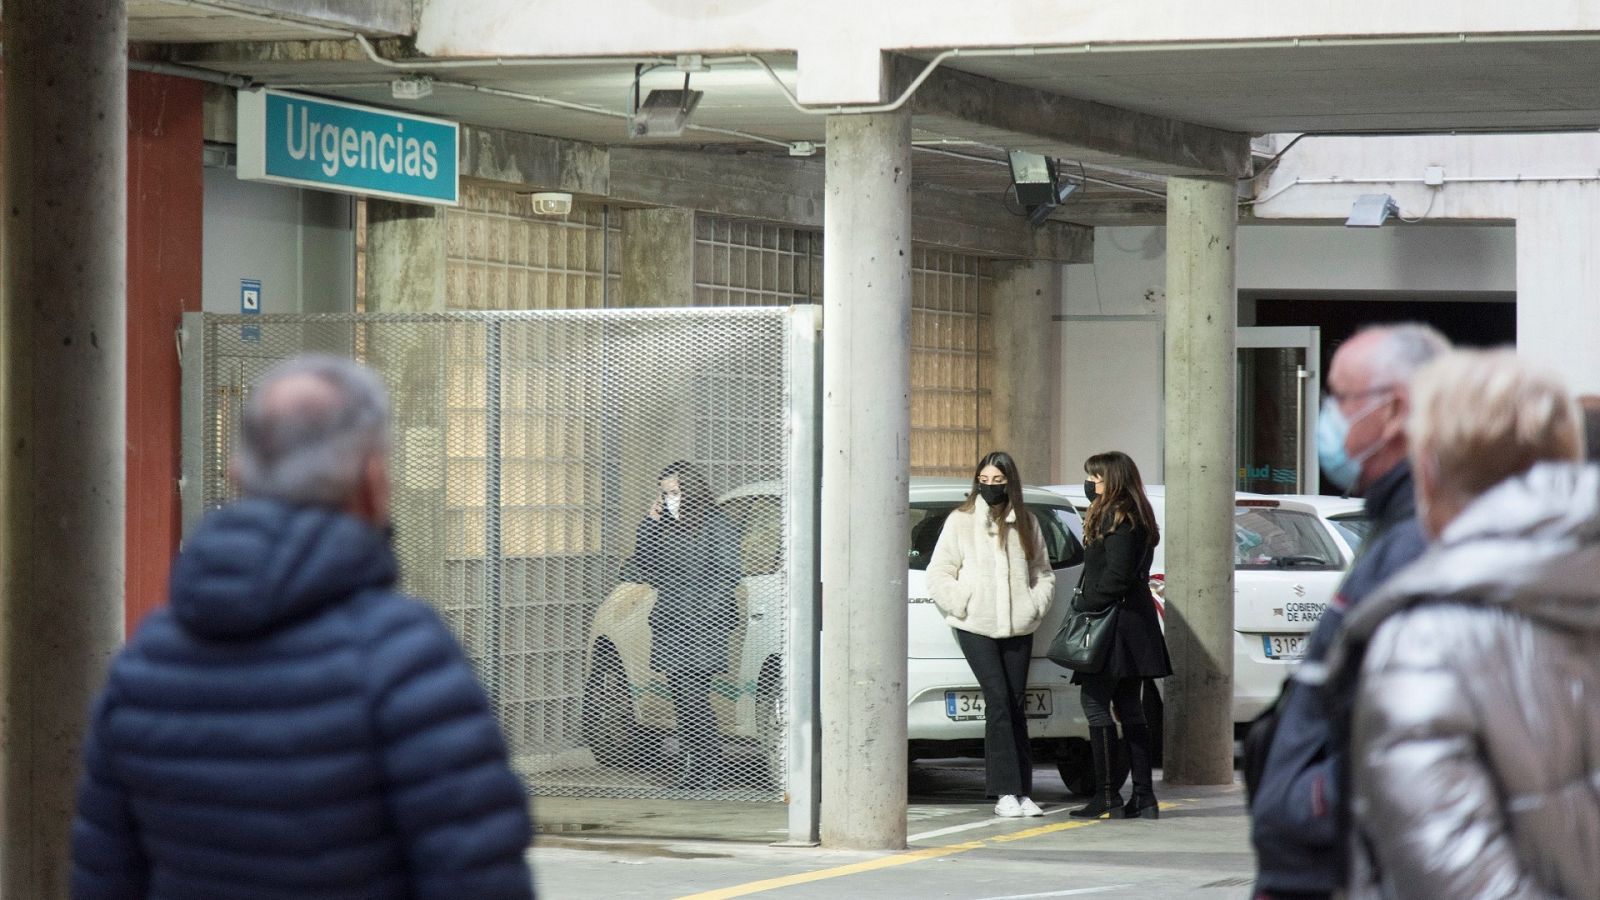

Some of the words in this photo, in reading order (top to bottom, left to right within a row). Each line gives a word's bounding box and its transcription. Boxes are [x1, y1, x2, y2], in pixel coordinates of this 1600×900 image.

[286, 103, 438, 180] Urgencias
[1238, 464, 1270, 478] alud
[1286, 602, 1327, 612] GOBIERNO
[1287, 612, 1299, 622] DE
[1302, 612, 1322, 622] ARA
[960, 694, 982, 712] 34
[1024, 693, 1046, 711] FX
